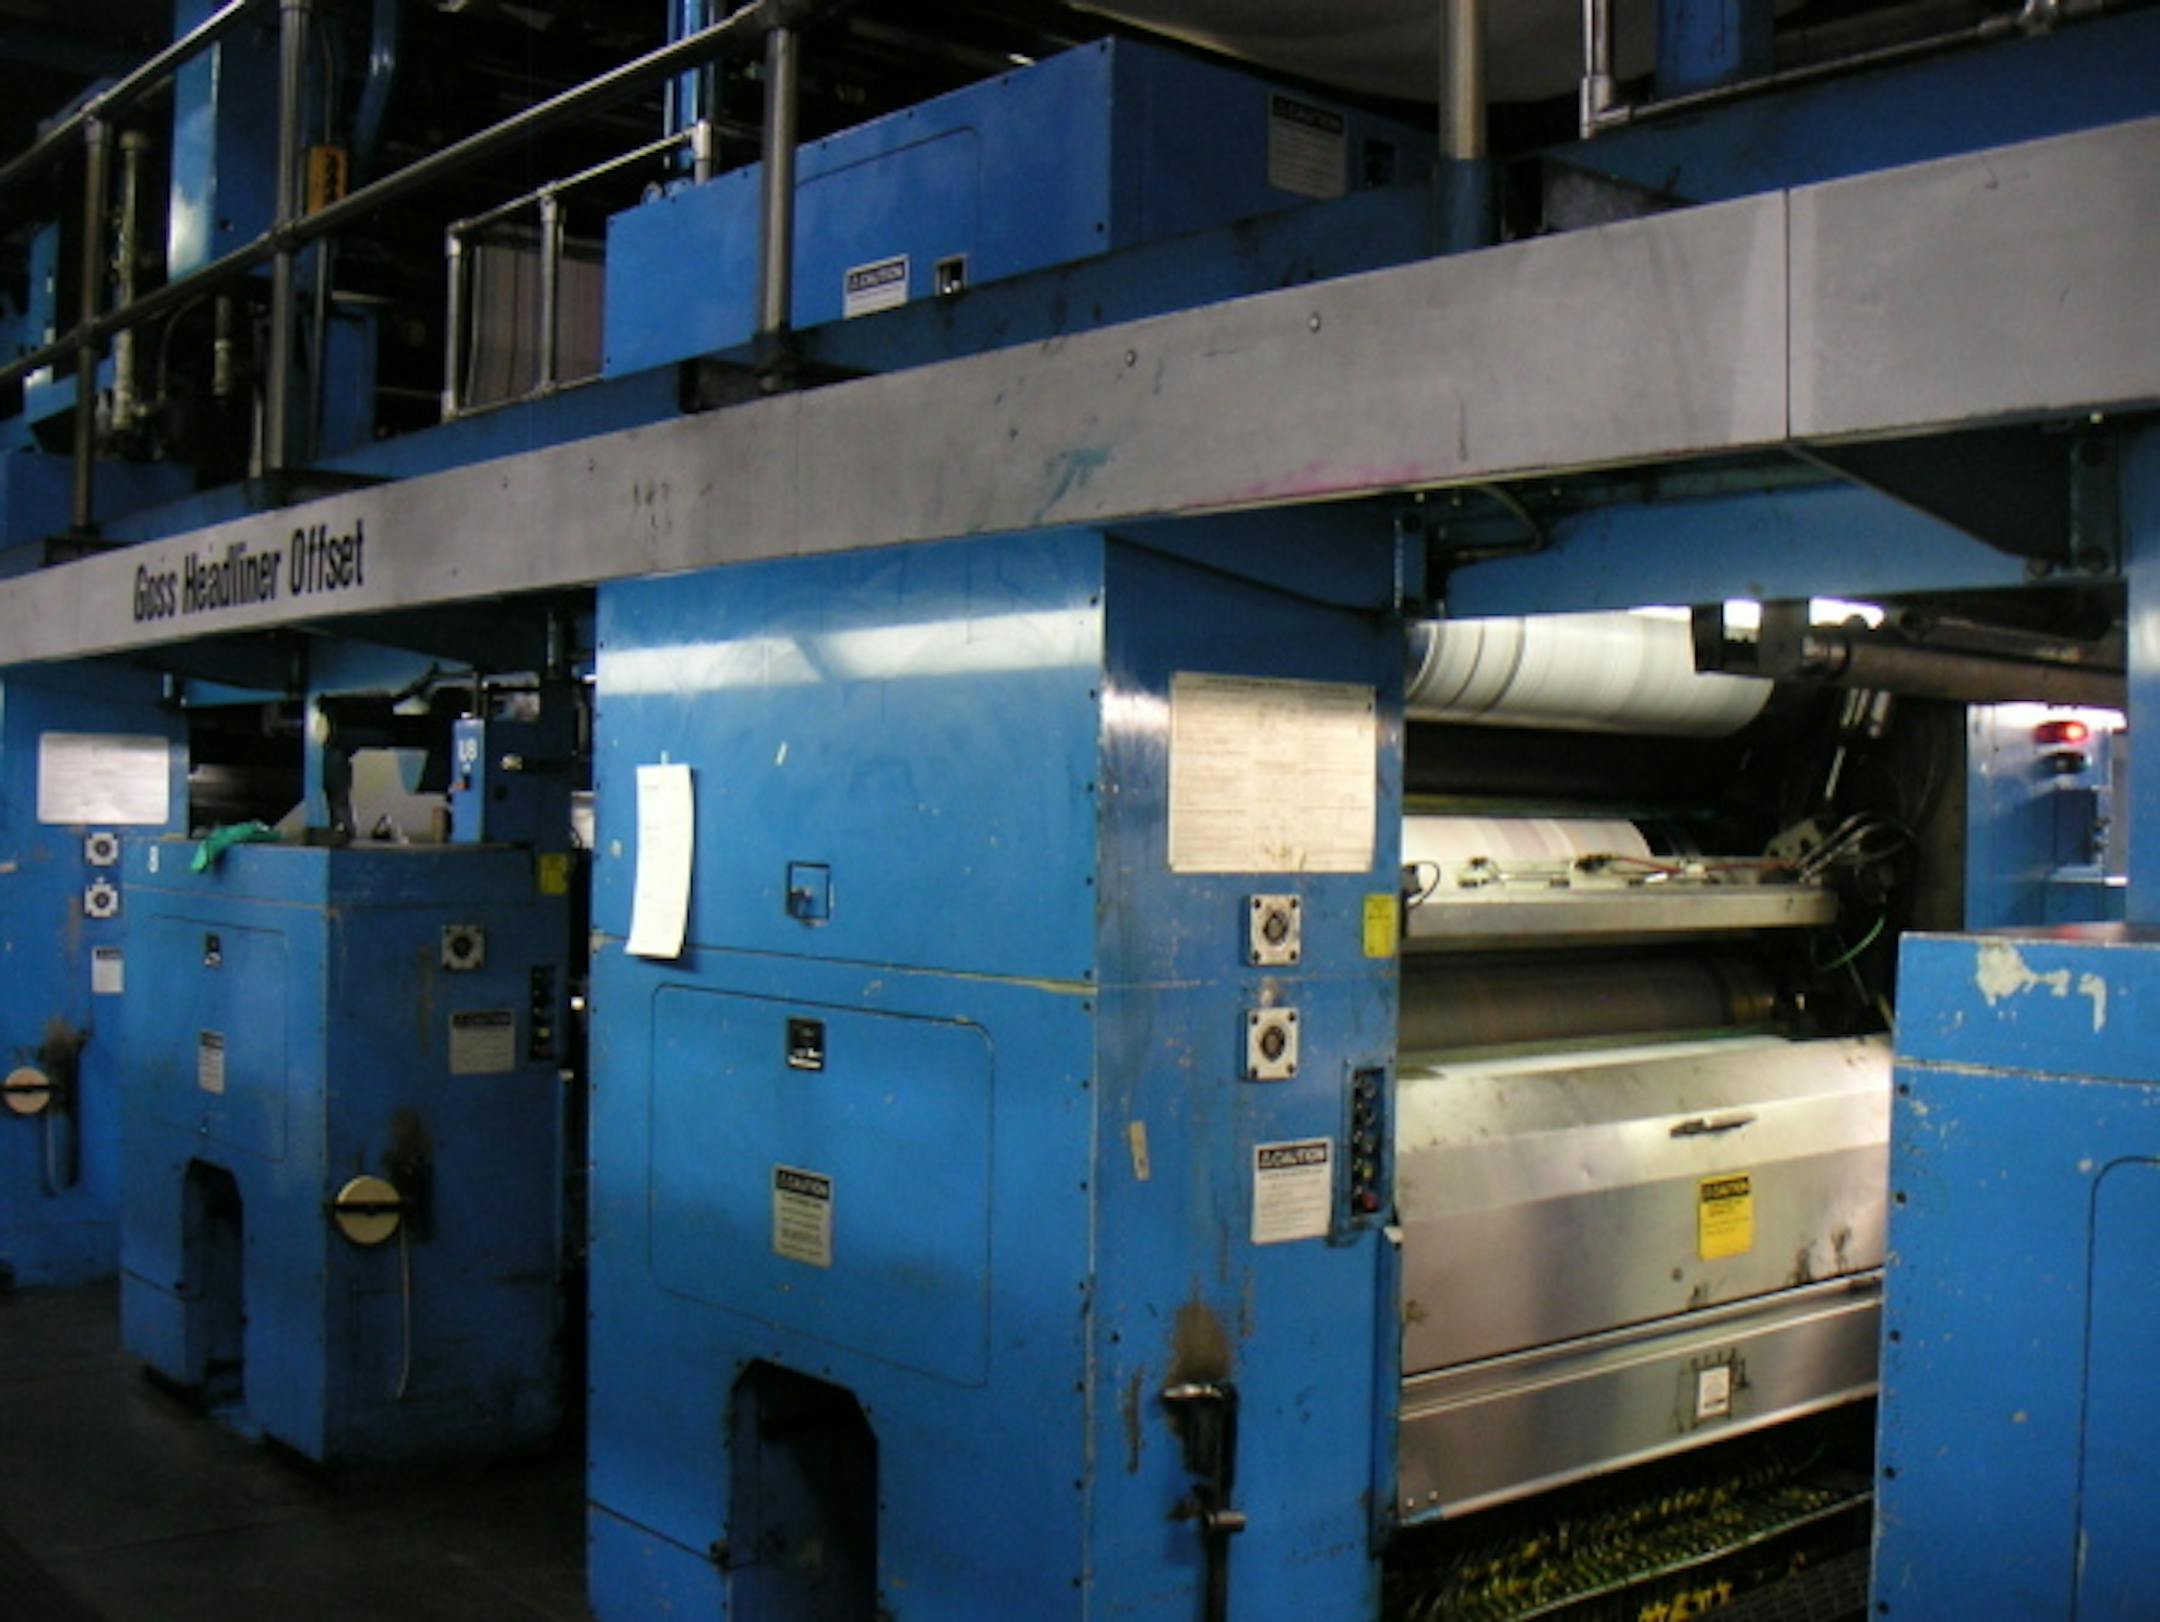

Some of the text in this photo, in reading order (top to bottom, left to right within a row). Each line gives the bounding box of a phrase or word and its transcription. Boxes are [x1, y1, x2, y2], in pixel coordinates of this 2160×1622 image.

[859, 264, 904, 287] CAUTION
[134, 519, 366, 622] Goss Headliner Offset
[1273, 1146, 1326, 1165] CAUTION
[786, 1172, 828, 1198] CAUTION
